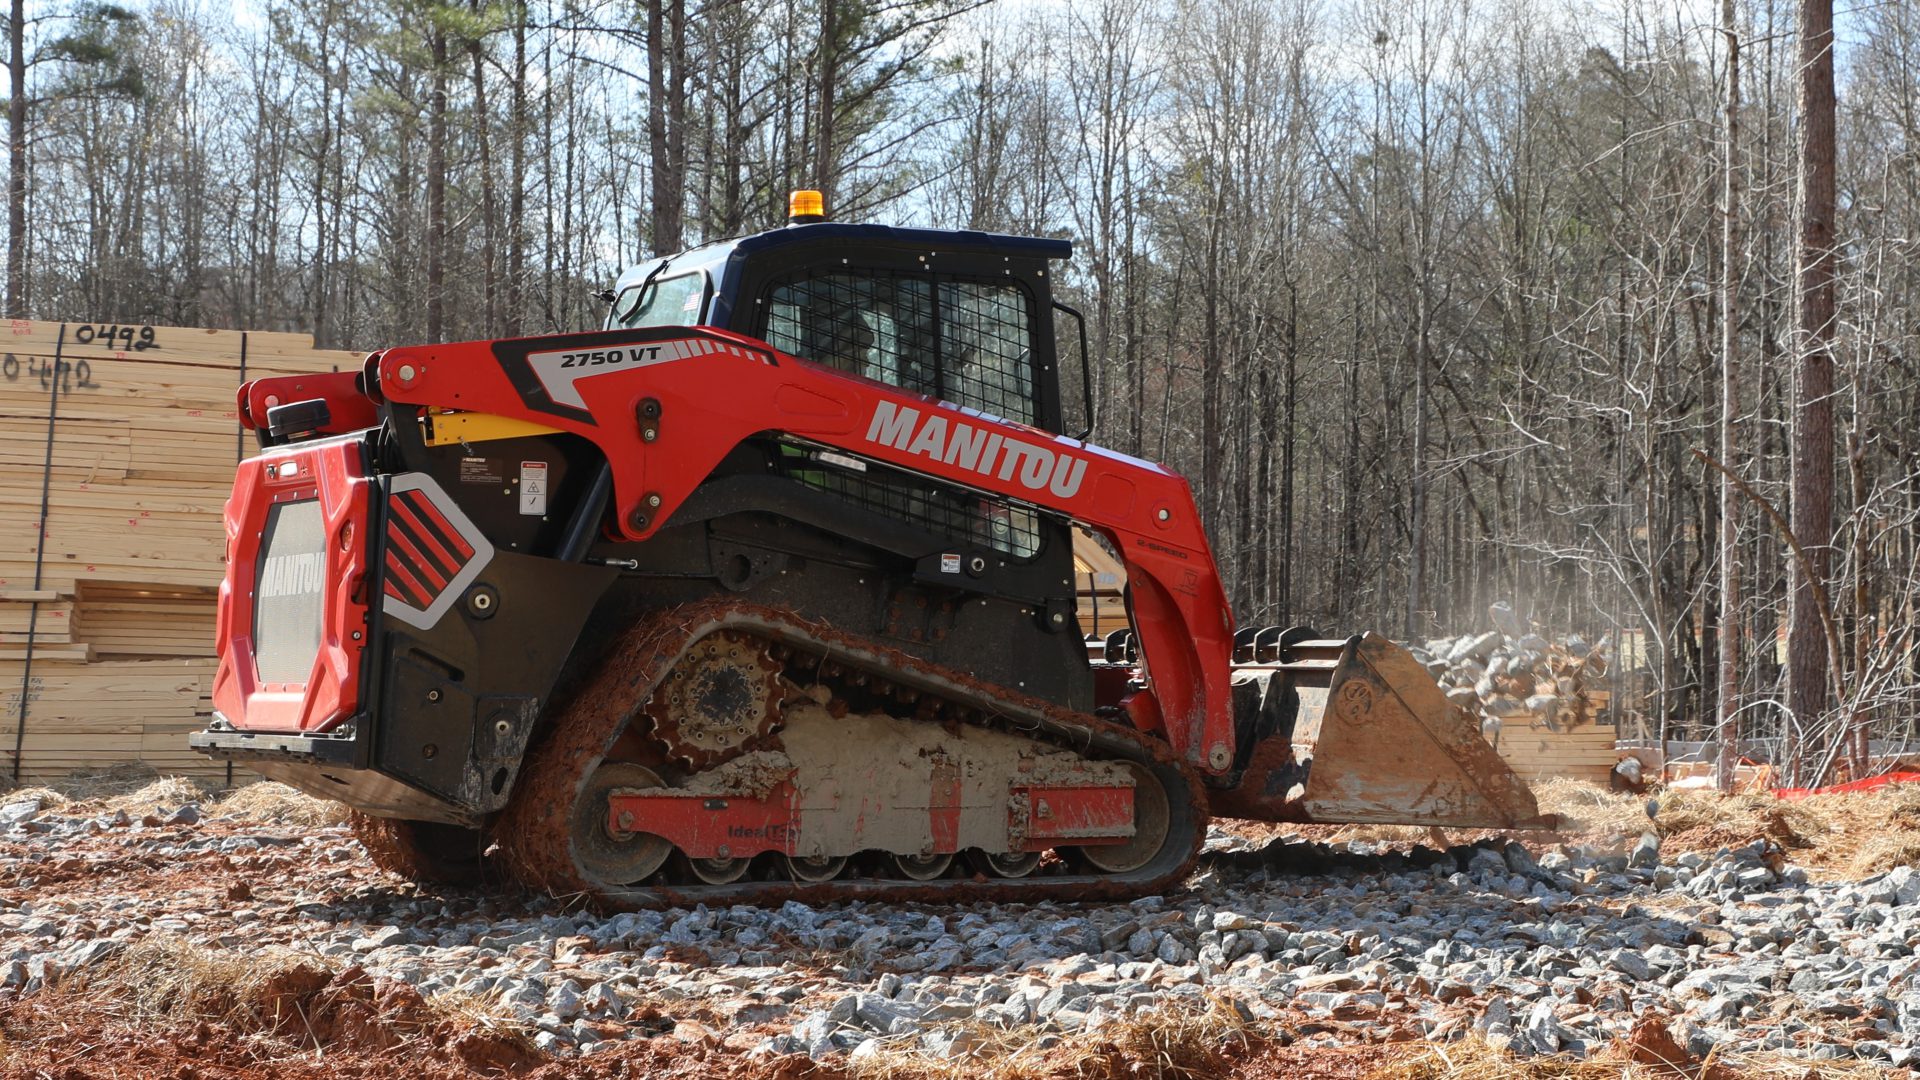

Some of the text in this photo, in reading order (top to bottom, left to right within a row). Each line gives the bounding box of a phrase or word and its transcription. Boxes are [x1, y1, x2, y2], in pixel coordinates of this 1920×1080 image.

[560, 347, 661, 368] 2750 VT
[866, 400, 1088, 498] MANITOU
[261, 552, 326, 598] MANITOU
